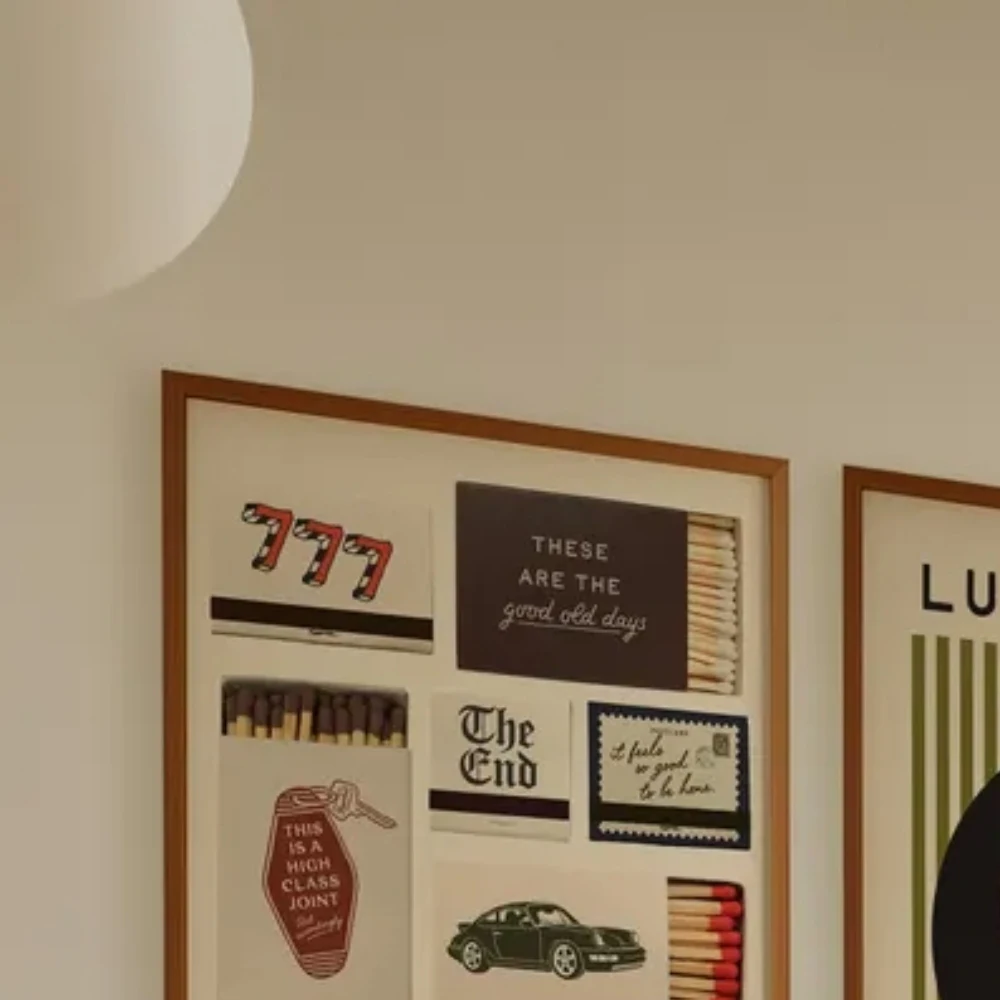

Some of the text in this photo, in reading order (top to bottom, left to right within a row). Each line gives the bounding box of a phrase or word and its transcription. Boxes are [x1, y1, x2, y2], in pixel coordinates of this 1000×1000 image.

[241, 503, 393, 602] 777
[531, 535, 609, 561] THESE
[518, 568, 621, 595] ARE THE
[499, 599, 647, 643] good old days
[459, 704, 535, 754] The
[626, 732, 664, 764] feels
[459, 747, 537, 789] End
[649, 749, 689, 781] good
[639, 782, 657, 800] to
[284, 822, 323, 838] THIS
[288, 840, 323, 855] IS A
[286, 856, 331, 873] HIGH
[281, 875, 341, 893] CLASS
[289, 892, 339, 910] JOINT
